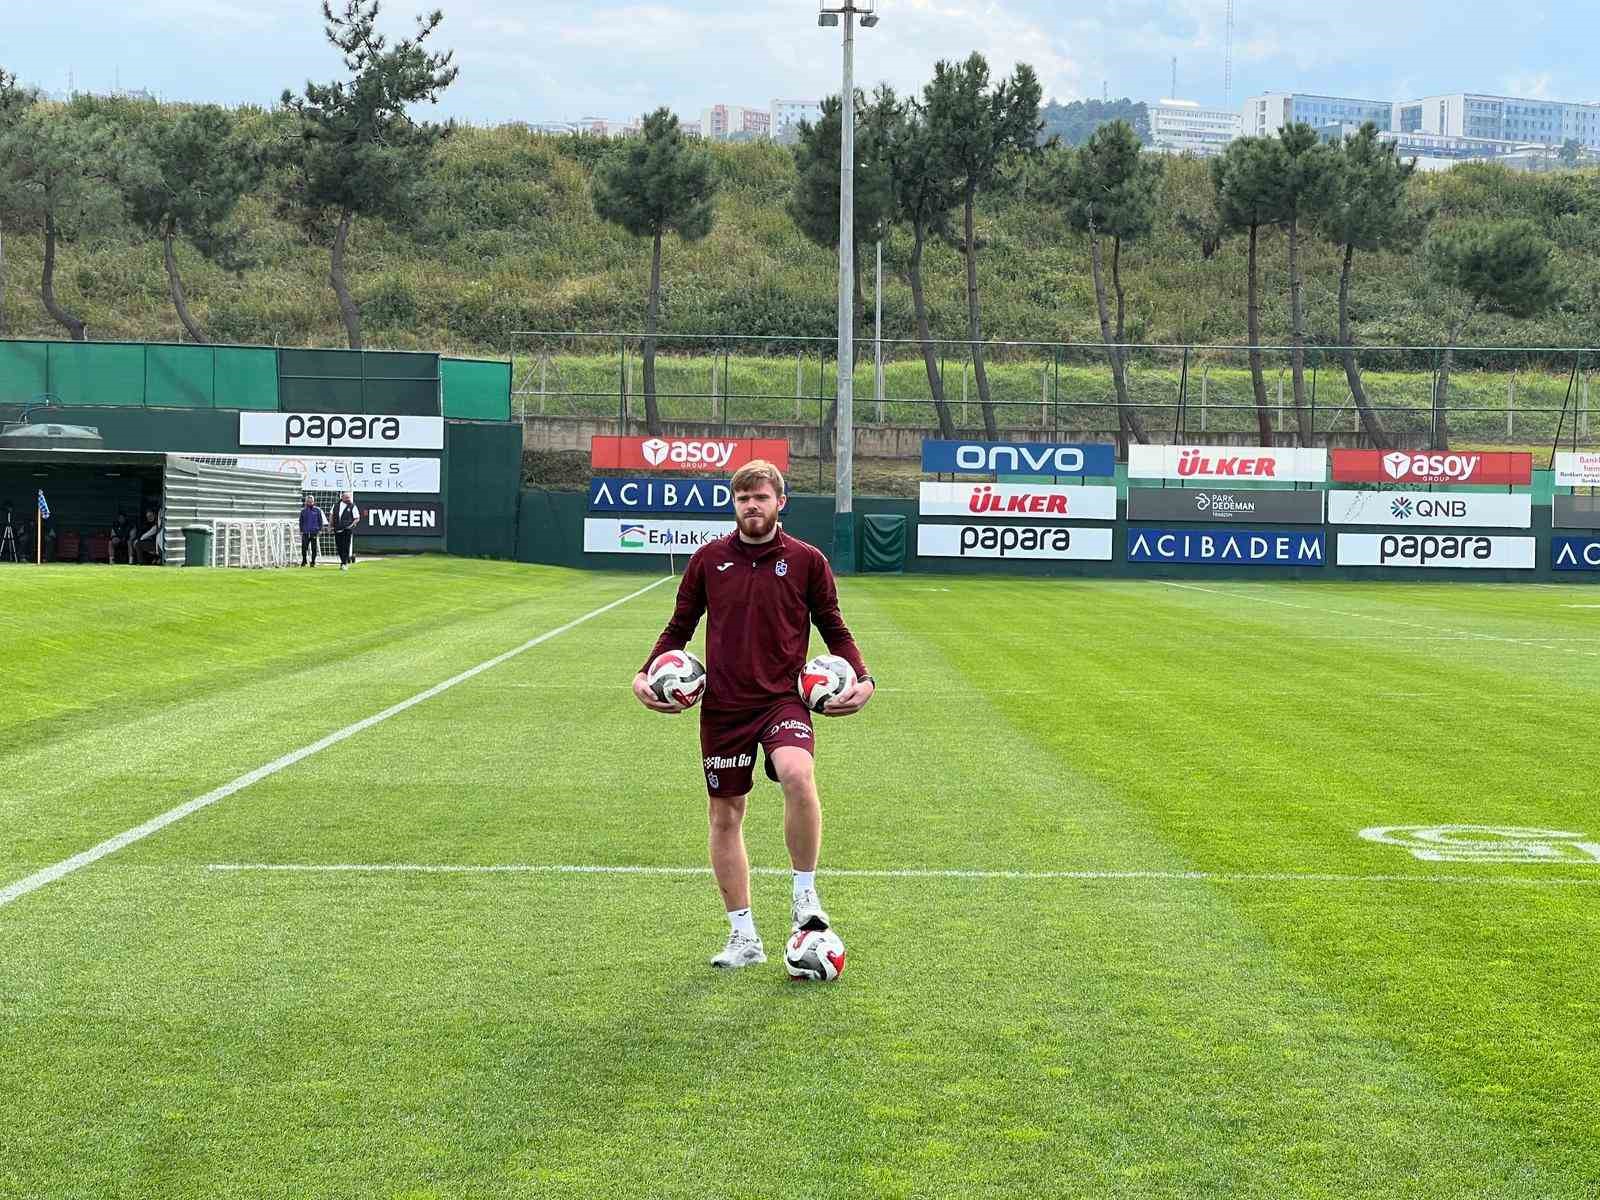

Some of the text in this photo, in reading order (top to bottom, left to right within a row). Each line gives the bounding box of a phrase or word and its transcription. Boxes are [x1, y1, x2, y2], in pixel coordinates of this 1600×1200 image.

[285, 415, 400, 445] papara
[670, 441, 734, 467] asoy
[956, 445, 1084, 472] onvo
[1177, 449, 1277, 477] ÜLKER
[1411, 454, 1474, 480] asoy
[315, 462, 400, 474] REGES
[594, 482, 731, 506] ACIBAD
[968, 486, 1069, 514] ÜLKER
[1212, 494, 1234, 502] PARK
[1212, 501, 1255, 511] DEDEMAN
[368, 509, 436, 527] TWEEN
[1416, 499, 1467, 517] QNB
[960, 526, 1070, 555] papara
[1131, 534, 1322, 560] ACIBADEM
[1380, 535, 1492, 565] papara
[738, 753, 752, 767] Go
